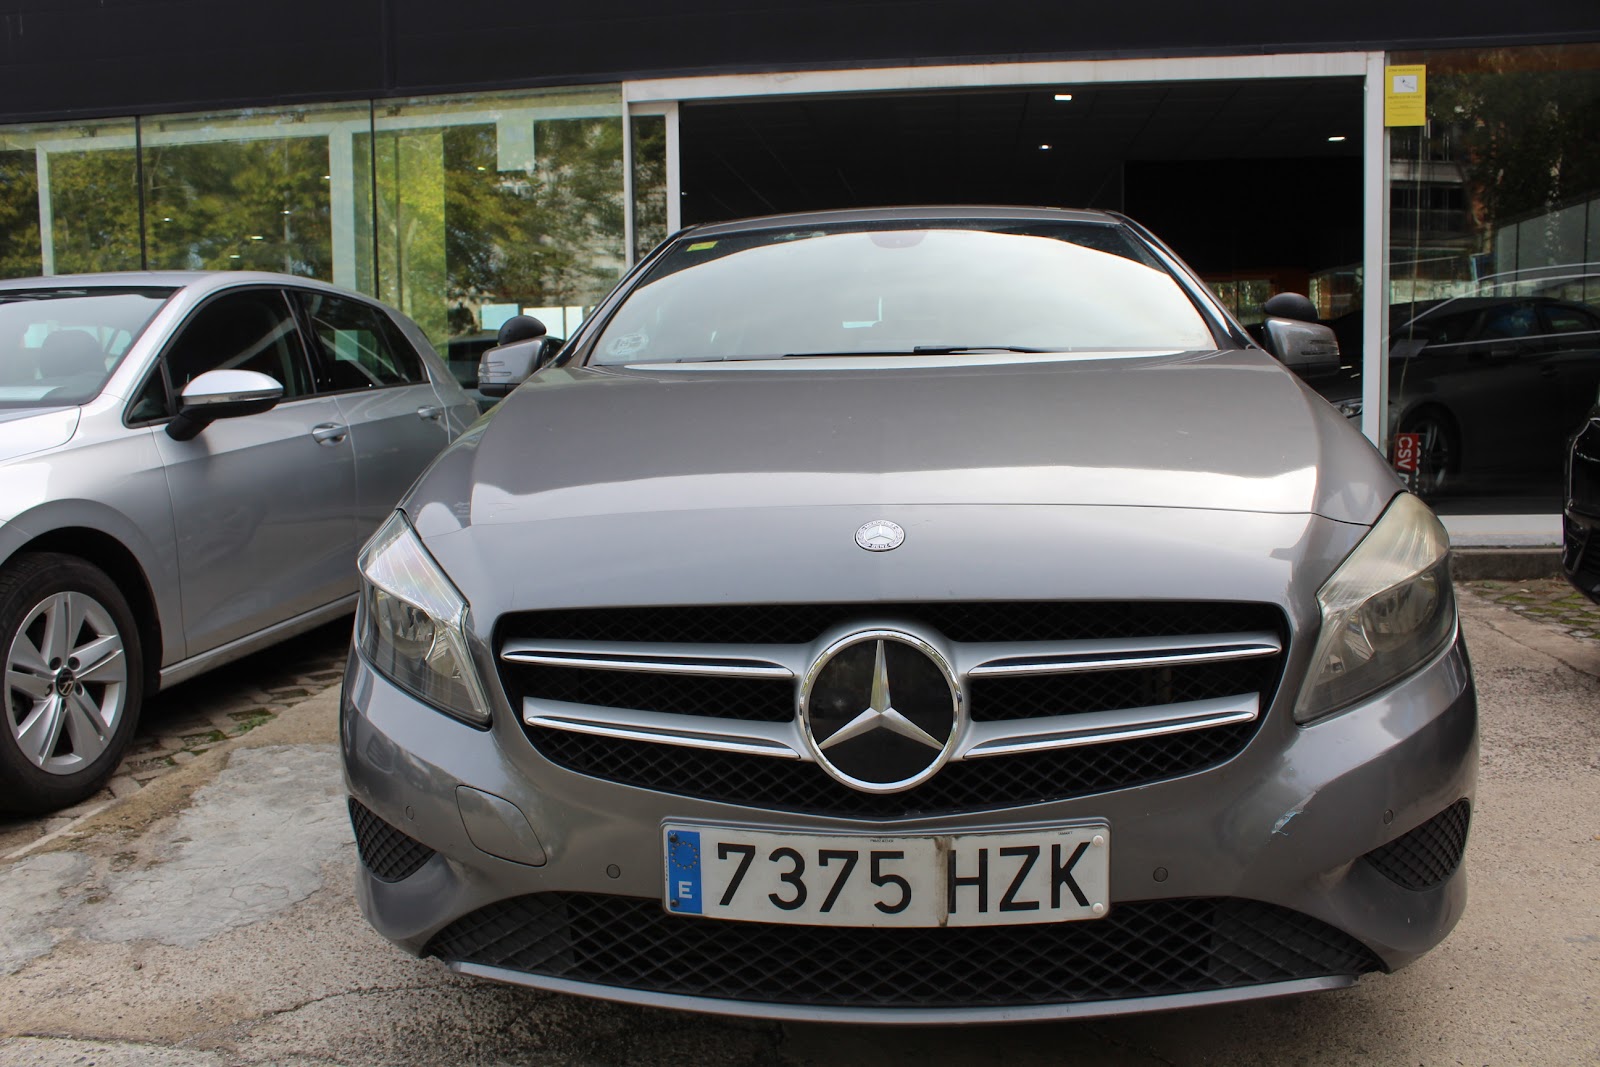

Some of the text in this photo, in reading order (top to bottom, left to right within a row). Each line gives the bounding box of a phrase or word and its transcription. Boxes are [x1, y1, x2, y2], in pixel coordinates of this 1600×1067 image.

[678, 881, 692, 899] E
[718, 841, 1091, 914] 7375 HZK
